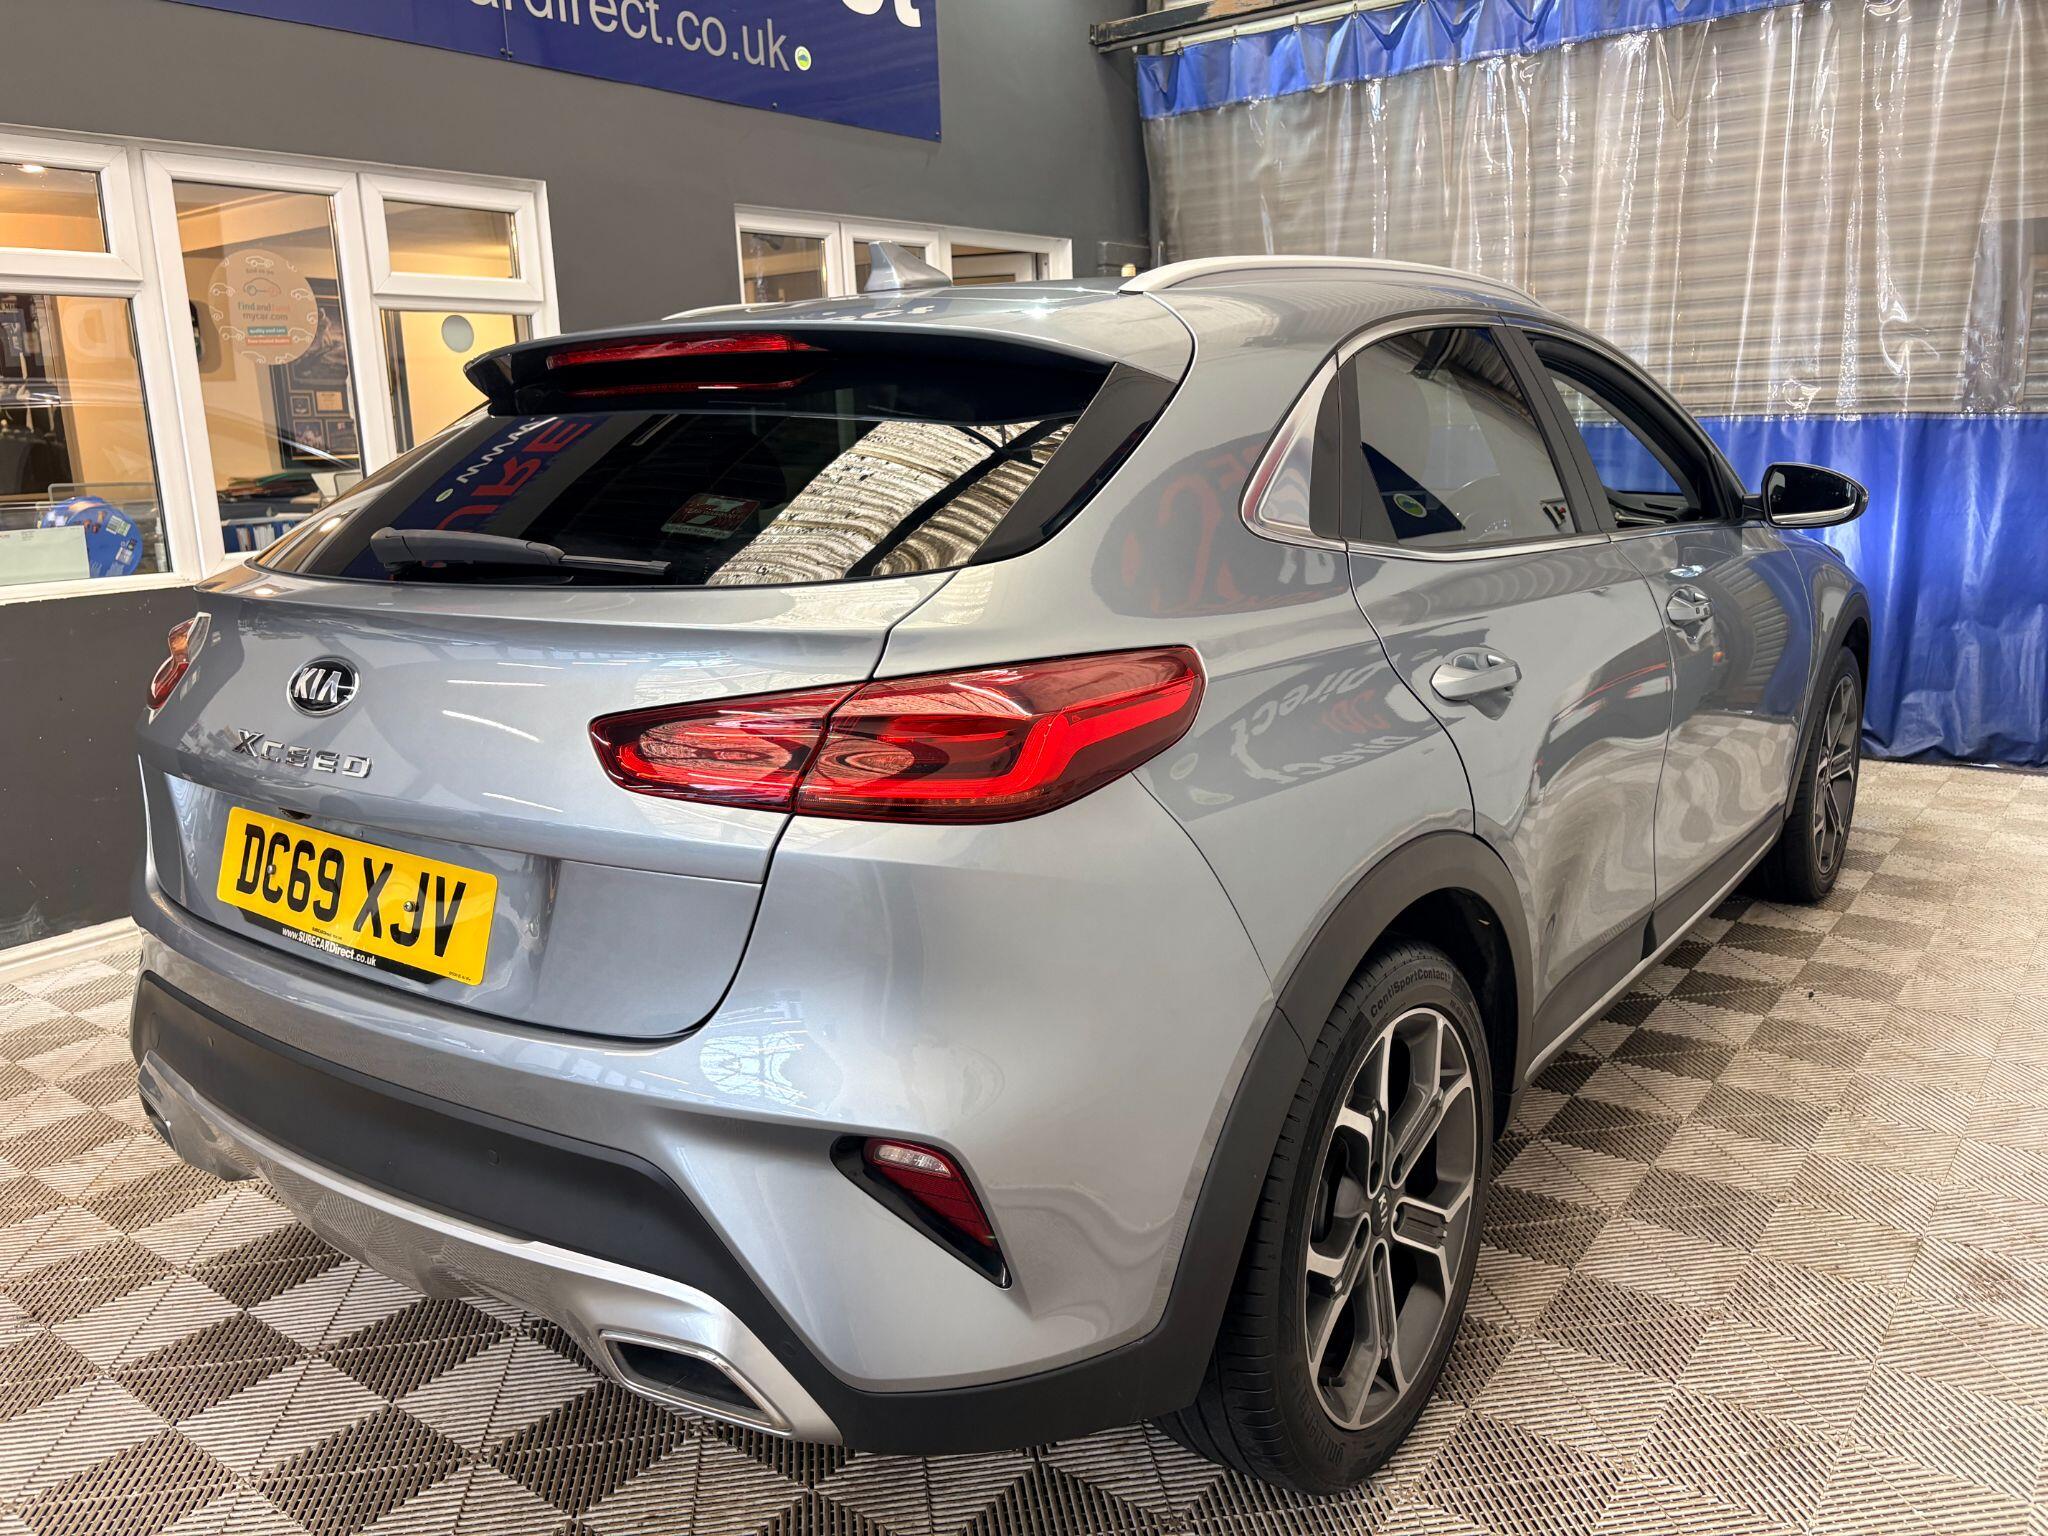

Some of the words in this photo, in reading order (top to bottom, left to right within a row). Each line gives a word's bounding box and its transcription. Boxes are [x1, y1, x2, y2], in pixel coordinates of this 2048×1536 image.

[470, 0, 790, 71] ect.co.uk
[293, 667, 342, 703] KIA
[236, 823, 345, 923] DC69
[353, 857, 467, 958] XJV
[282, 927, 377, 967] www.SURECARDirect.co.uk
